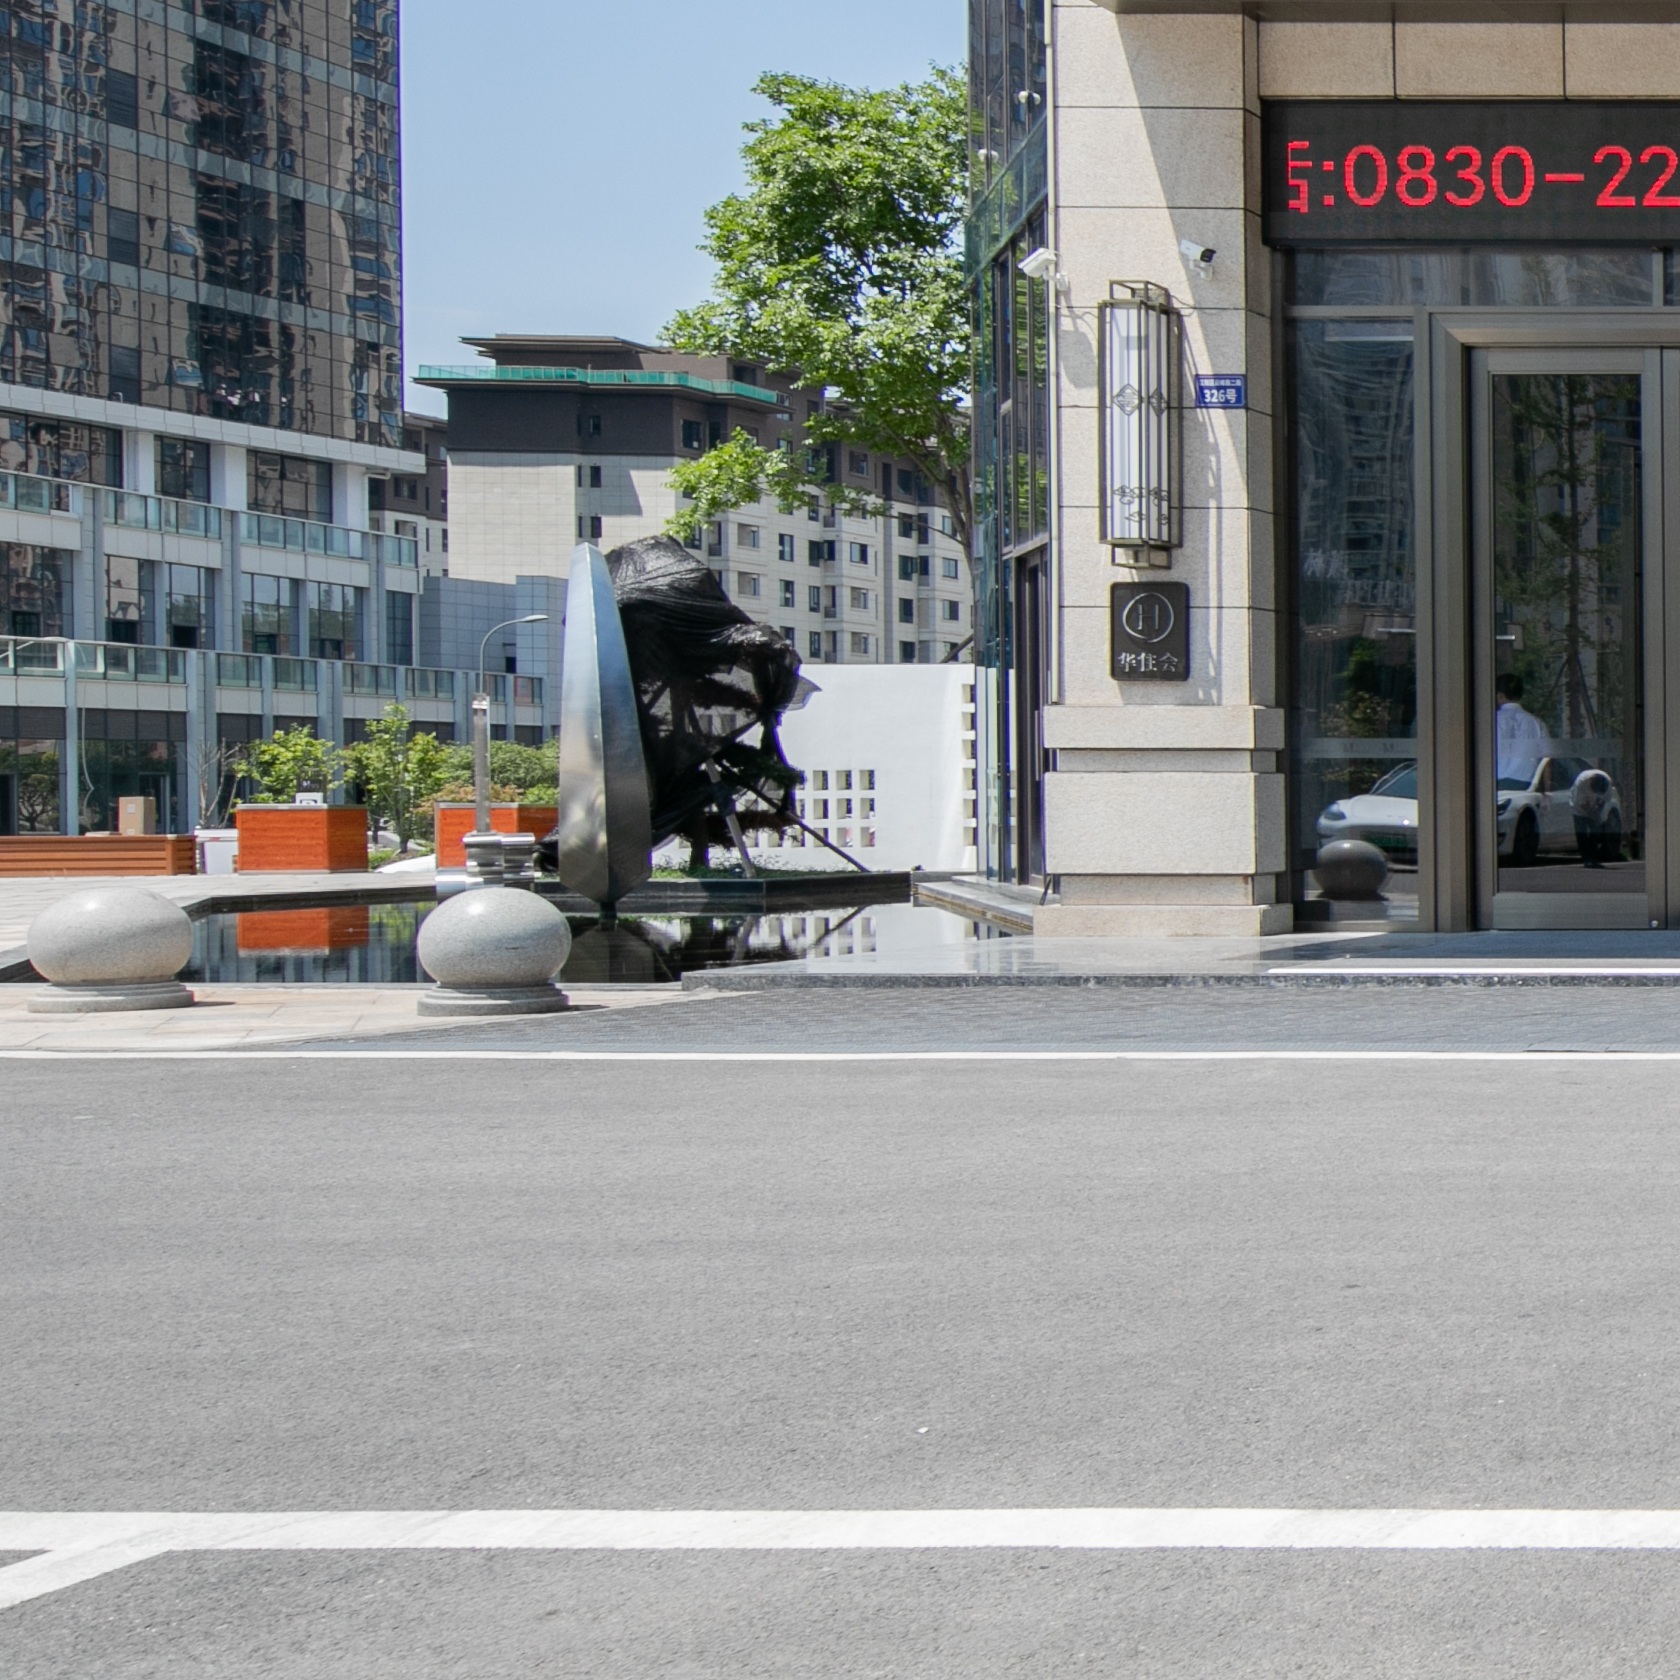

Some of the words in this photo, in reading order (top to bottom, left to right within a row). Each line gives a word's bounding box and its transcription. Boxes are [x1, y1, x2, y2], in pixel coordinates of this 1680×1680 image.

[1203, 388, 1238, 404] 326号
[1117, 651, 1179, 673] 华住会
